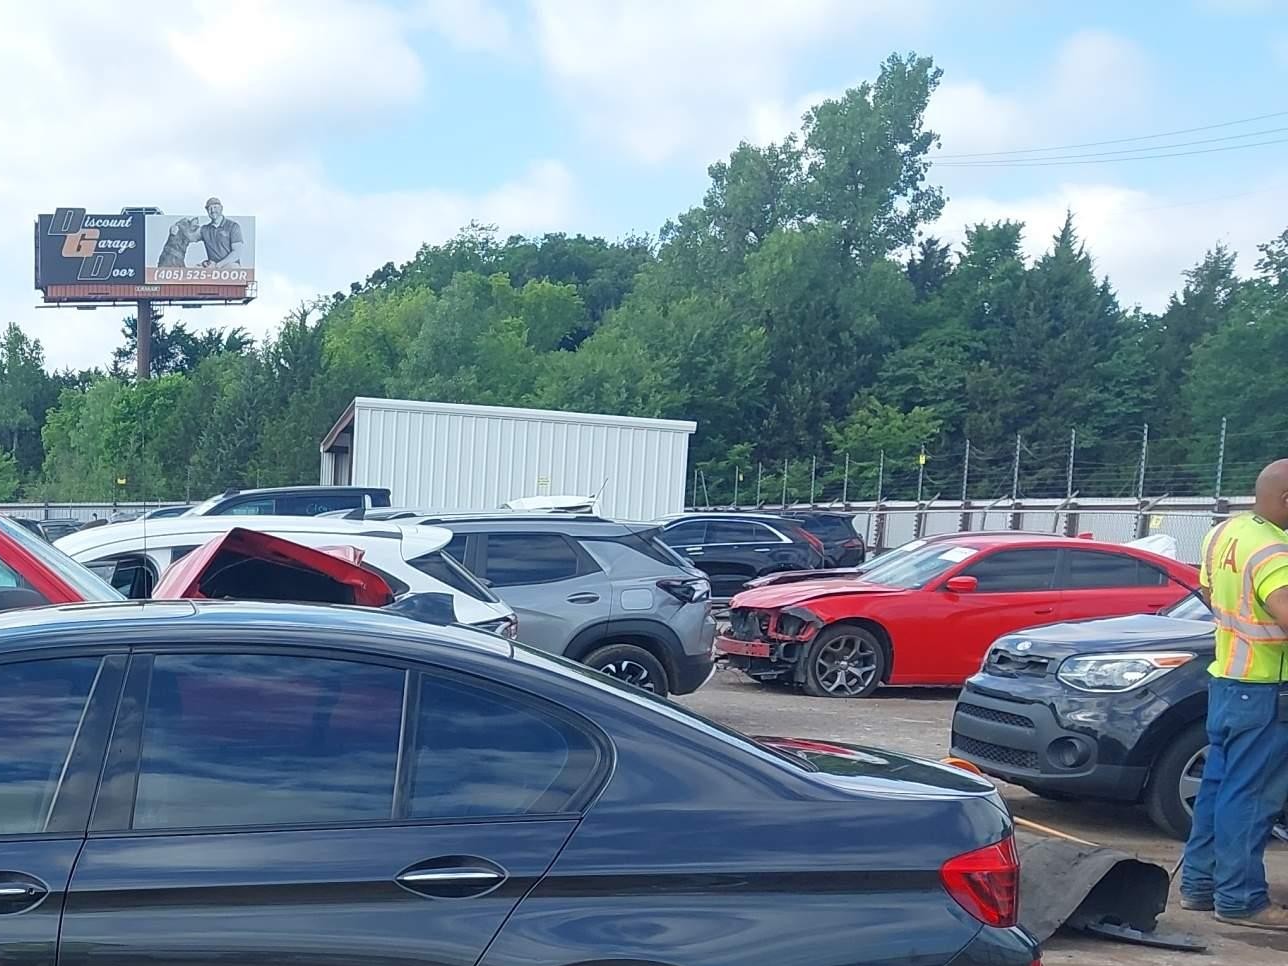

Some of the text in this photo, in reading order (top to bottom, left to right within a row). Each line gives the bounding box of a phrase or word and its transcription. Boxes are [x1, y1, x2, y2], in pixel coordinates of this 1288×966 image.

[48, 208, 133, 235] Discount
[62, 229, 137, 257] Garage
[78, 252, 135, 280] Door
[154, 269, 248, 281] (405) 525-DOOR
